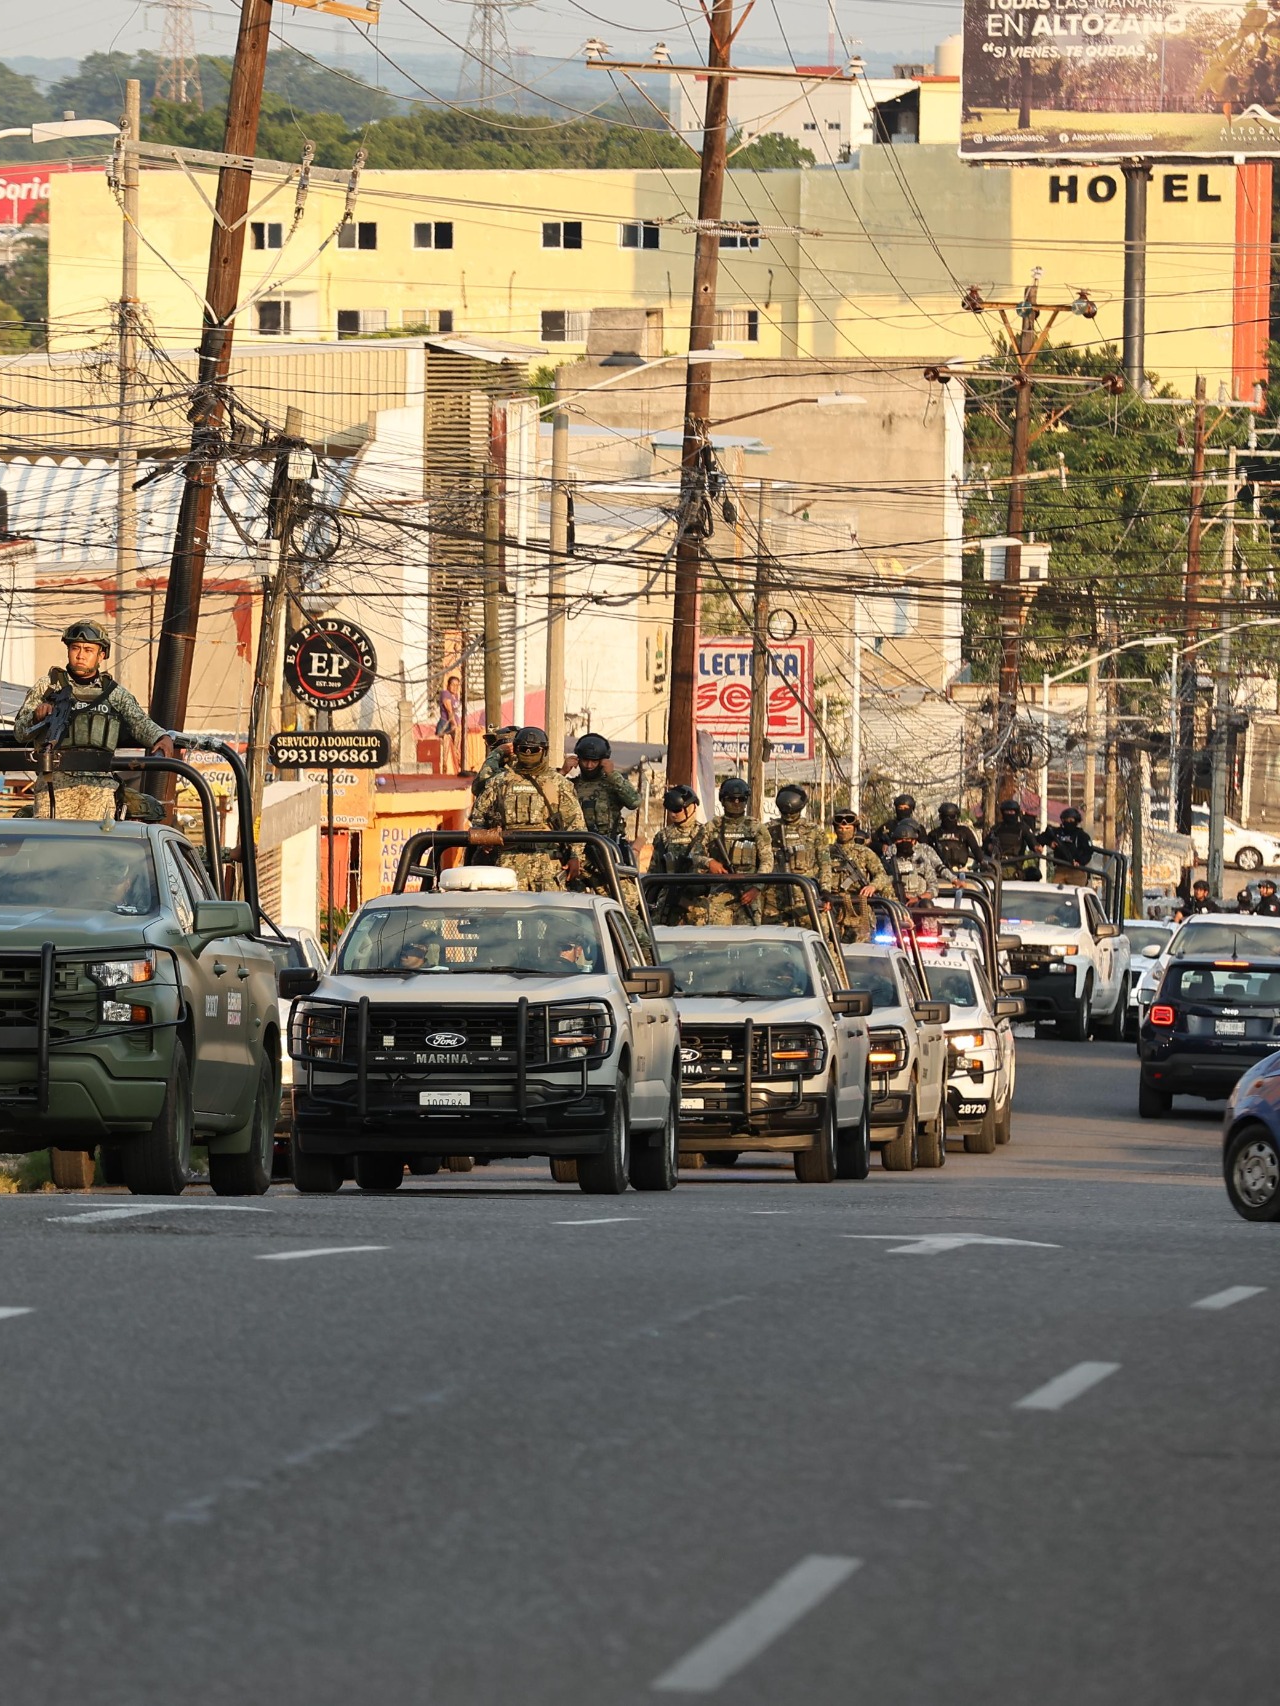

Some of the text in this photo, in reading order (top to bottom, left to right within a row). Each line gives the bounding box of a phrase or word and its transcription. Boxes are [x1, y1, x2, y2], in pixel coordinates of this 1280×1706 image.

[987, 13, 1187, 37] EN ALTOZANO
[1010, 46, 1061, 59] VIENES,
[1066, 46, 1084, 57] TE
[1049, 174, 1222, 204] HOEL
[287, 621, 373, 667] EL PADRINO
[308, 652, 350, 678] EP
[699, 653, 798, 677] LECTCA
[296, 686, 361, 708] TAQUERIA
[277, 736, 380, 748] SERVICIO A DOMICILIO:
[277, 749, 378, 763] 9931896861
[308, 770, 356, 784] saón
[432, 1034, 458, 1046] Ford
[416, 1053, 469, 1064] MARINA
[958, 1103, 987, 1115] 28720
